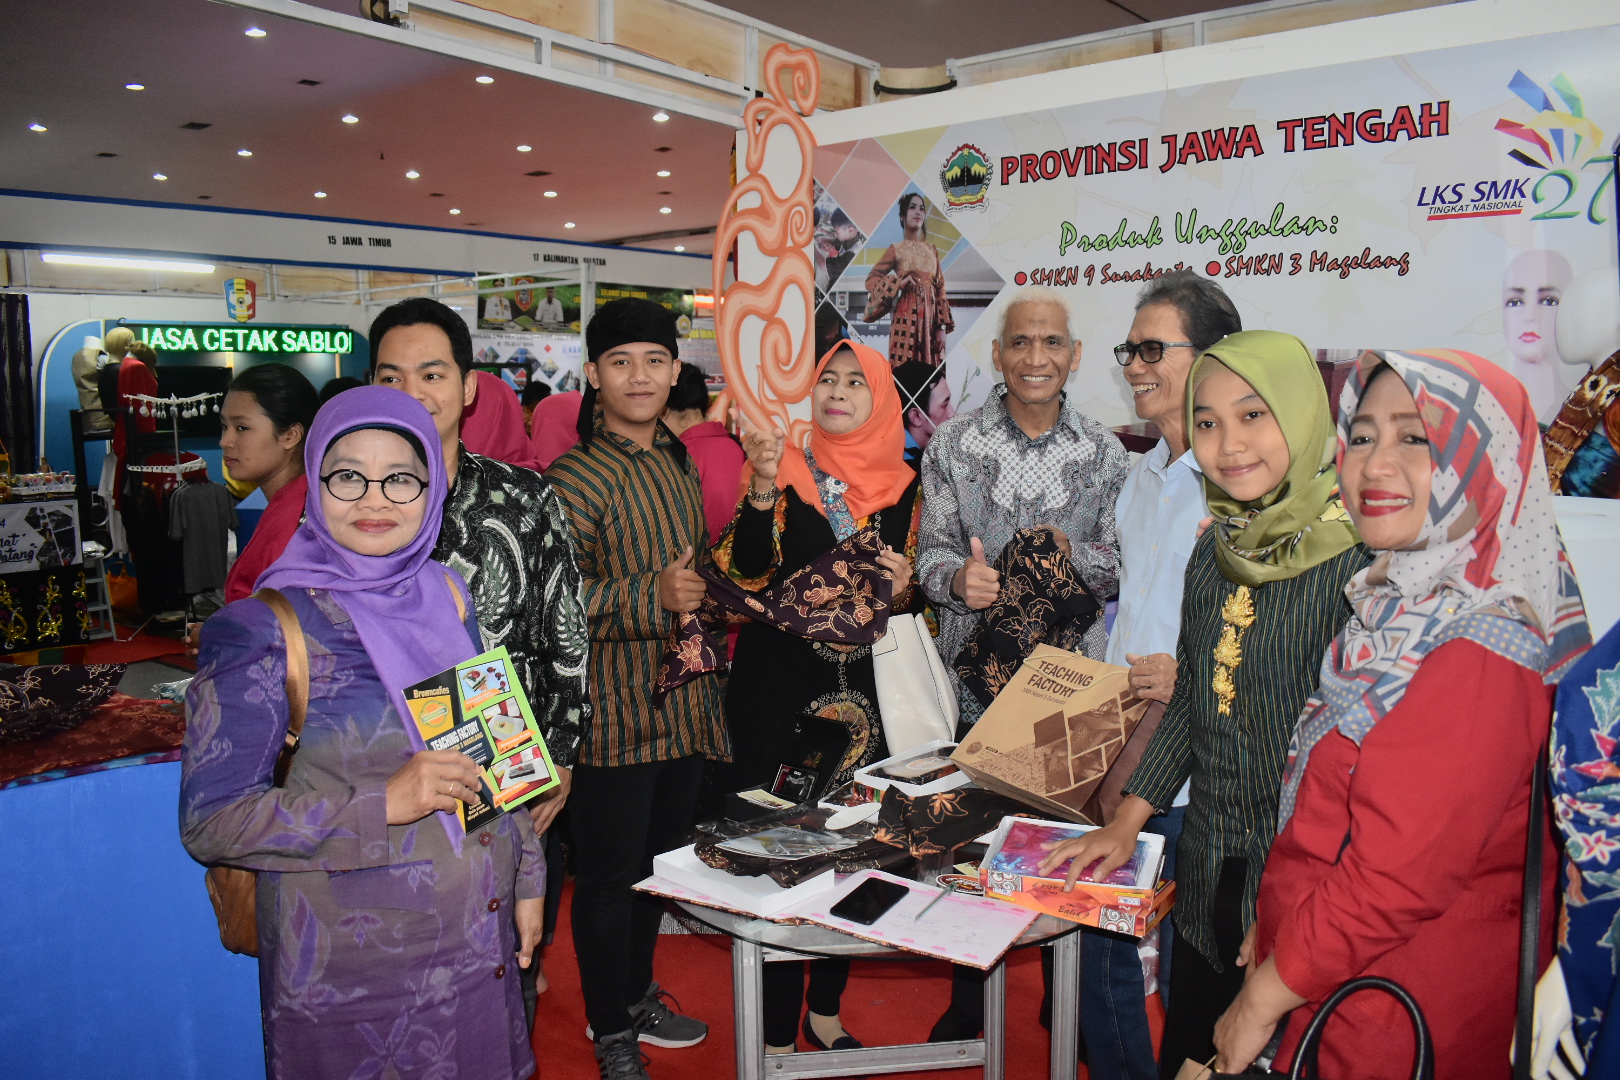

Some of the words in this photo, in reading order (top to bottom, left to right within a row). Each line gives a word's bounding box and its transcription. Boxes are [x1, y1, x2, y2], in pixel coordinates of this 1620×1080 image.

[1000, 137, 1149, 186] PROVINSI
[1158, 124, 1264, 174] JAWA
[1277, 100, 1450, 153] TENGAH
[1417, 183, 1466, 207] LKS
[1470, 177, 1531, 204] SMK
[1530, 154, 1615, 226] 27
[1428, 204, 1470, 215] TINGKAT
[1472, 200, 1524, 212] NASIONAL
[327, 235, 337, 245] 15
[342, 236, 363, 246] JAWA
[368, 237, 392, 248] TIMUR
[1059, 216, 1163, 256] Produk
[1175, 202, 1339, 256] Unggulan:
[543, 254, 579, 265] KALIMANTAN
[1224, 252, 1283, 278] SMKN
[1289, 253, 1302, 276] 3
[1309, 247, 1410, 279] Magelang
[1030, 263, 1079, 287] SMKN
[1084, 263, 1096, 286] 9
[203, 328, 279, 352] CETAK
[1027, 674, 1077, 698] FACTORY
[1039, 660, 1094, 687] TEACHING
[430, 730, 460, 752] TEACHING
[456, 720, 480, 741] FACTORY
